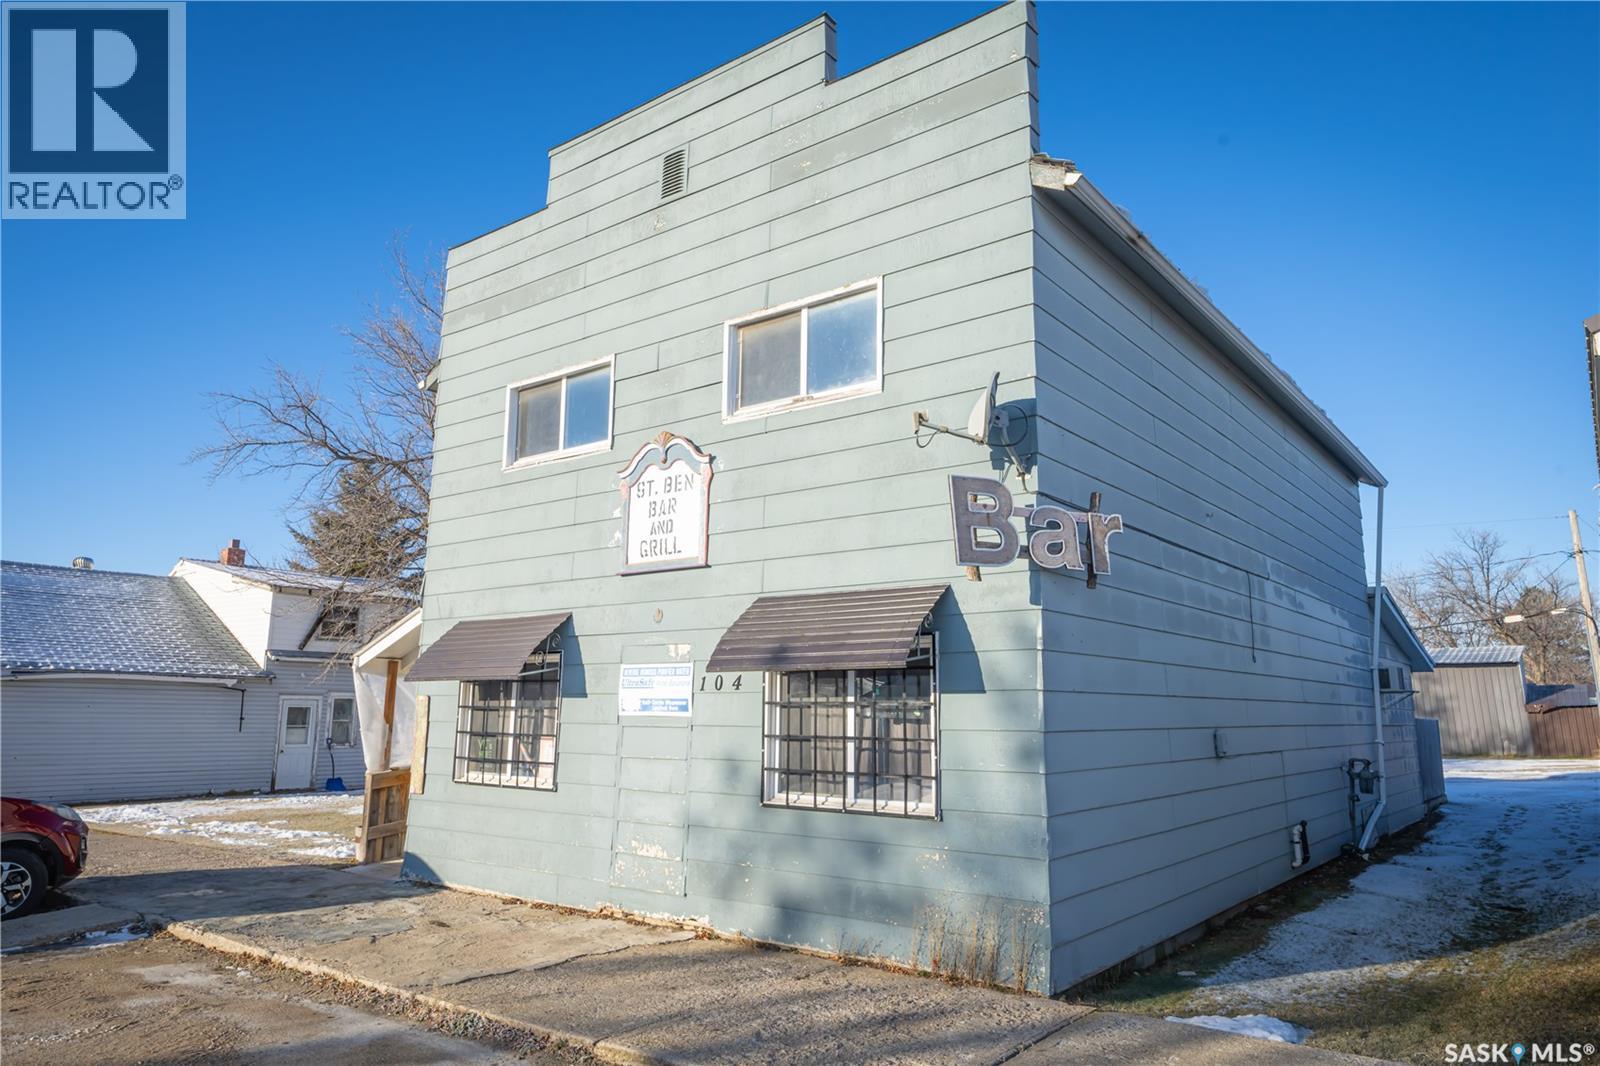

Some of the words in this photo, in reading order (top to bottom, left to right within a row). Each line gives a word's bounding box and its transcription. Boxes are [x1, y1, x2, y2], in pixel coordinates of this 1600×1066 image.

[636, 479, 658, 498] ST.
[663, 473, 694, 494] BEN
[648, 497, 677, 519] BAR
[649, 518, 674, 536] AND
[949, 474, 1124, 576] Bar
[639, 536, 682, 558] GRILL
